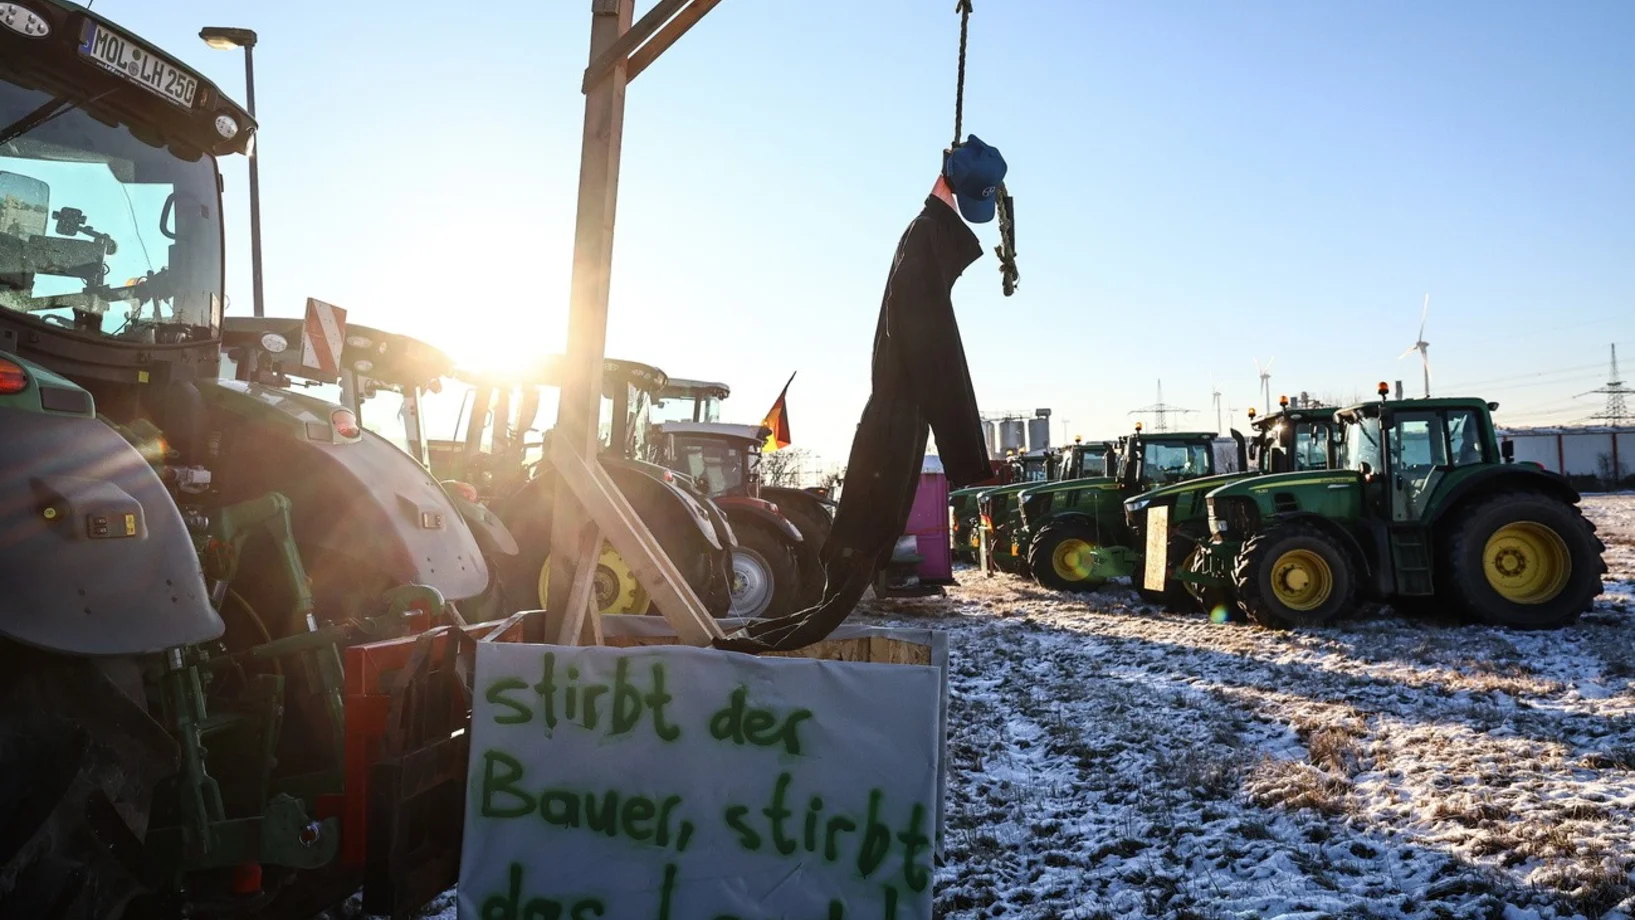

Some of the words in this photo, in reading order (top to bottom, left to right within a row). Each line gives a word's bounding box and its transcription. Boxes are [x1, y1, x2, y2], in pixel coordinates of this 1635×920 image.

[93, 28, 128, 70] MOL
[140, 55, 165, 89] LH
[164, 69, 195, 104] 250
[485, 652, 681, 742] stirbt
[710, 686, 813, 756] der
[482, 749, 694, 852] Bauer,
[725, 772, 933, 893] stirbt
